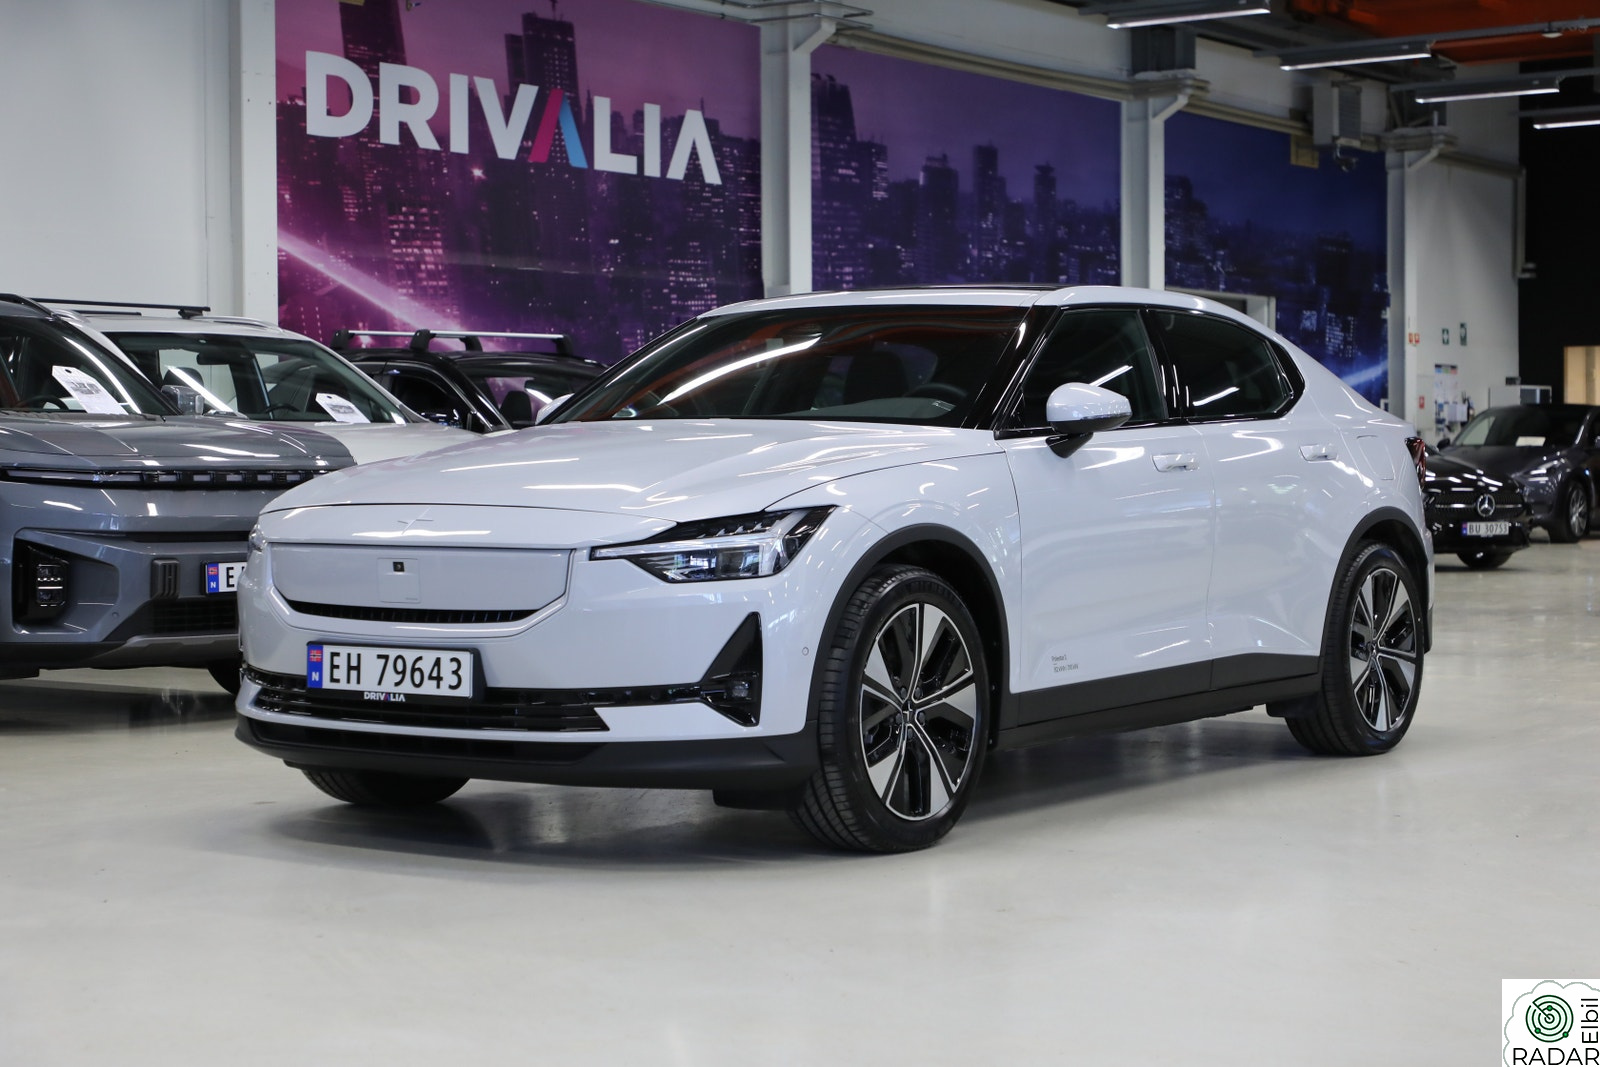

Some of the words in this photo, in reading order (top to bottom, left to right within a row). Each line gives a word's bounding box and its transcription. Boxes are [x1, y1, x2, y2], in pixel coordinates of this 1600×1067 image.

[306, 51, 722, 185] DRIVALIA
[1469, 524, 1481, 534] BU
[210, 581, 217, 589] N
[311, 671, 320, 682] N
[329, 652, 362, 685] EH
[376, 654, 463, 691] 79643
[363, 691, 406, 702] DRIVALIA
